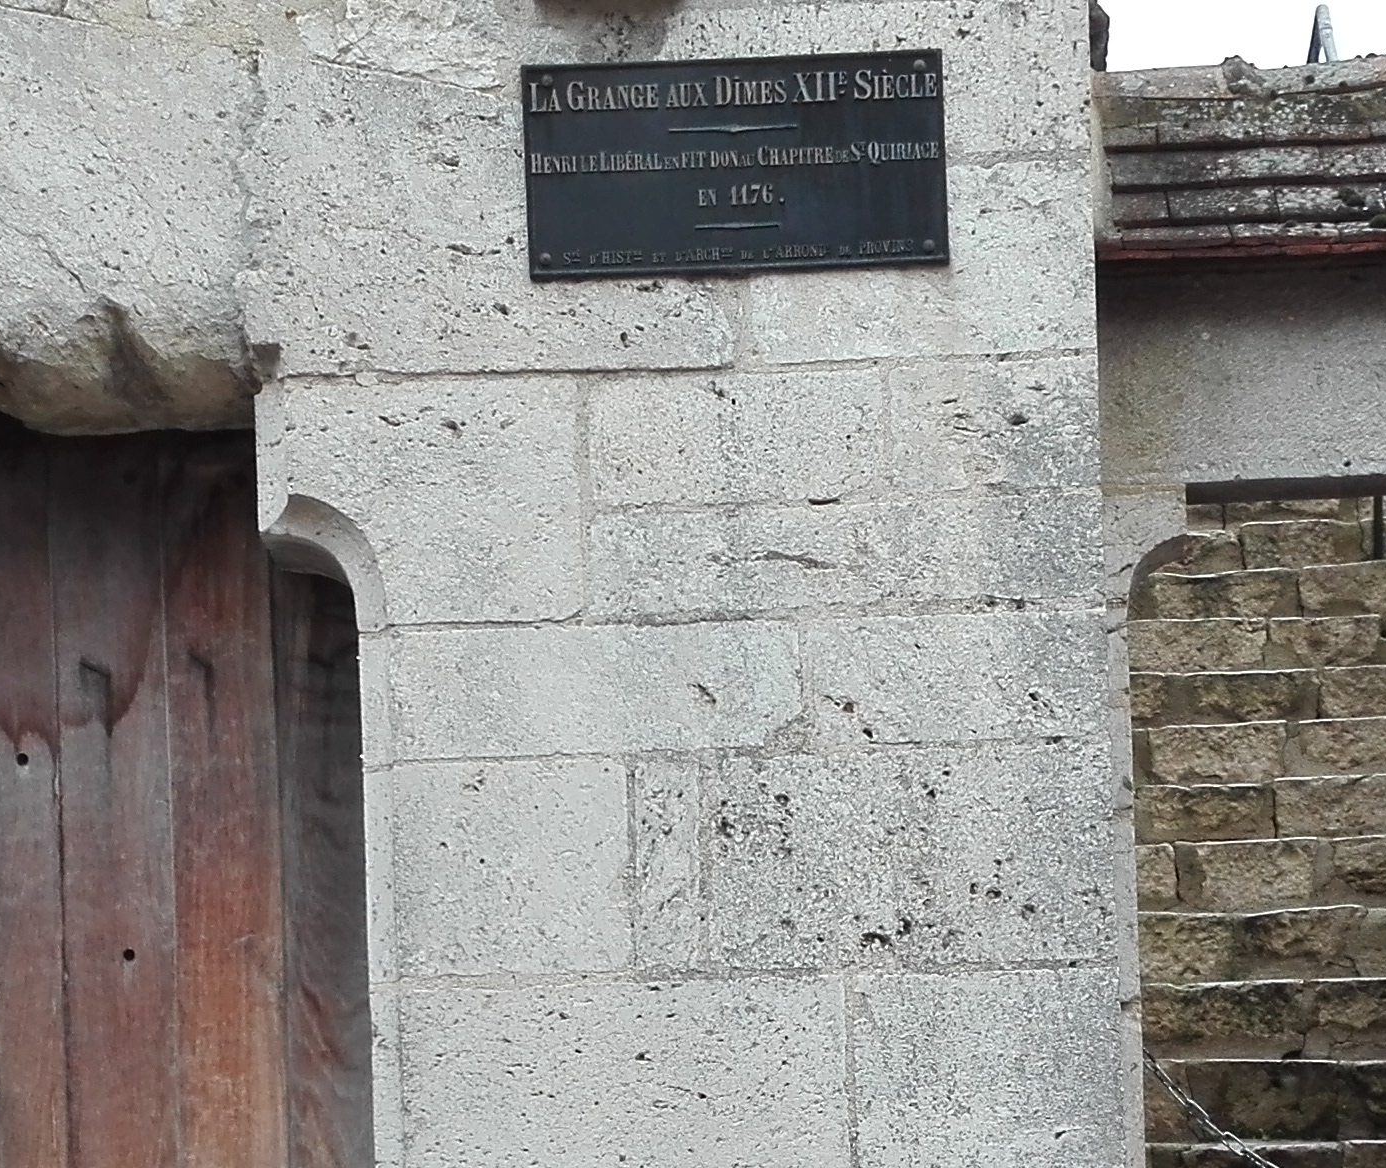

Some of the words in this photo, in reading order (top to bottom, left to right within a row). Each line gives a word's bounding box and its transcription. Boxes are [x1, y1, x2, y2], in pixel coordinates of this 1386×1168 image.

[566, 81, 659, 111] GRANGE
[666, 83, 709, 108] AUX
[715, 75, 787, 106] DÎMES
[853, 69, 938, 100] SIÈCLE
[530, 153, 578, 174] HENRI
[581, 155, 598, 172] LE
[599, 151, 662, 172] LIBÉRAL
[681, 151, 708, 168] FIT
[710, 150, 738, 168] DON
[757, 146, 834, 166] CHAPITRE
[698, 189, 717, 206] EN
